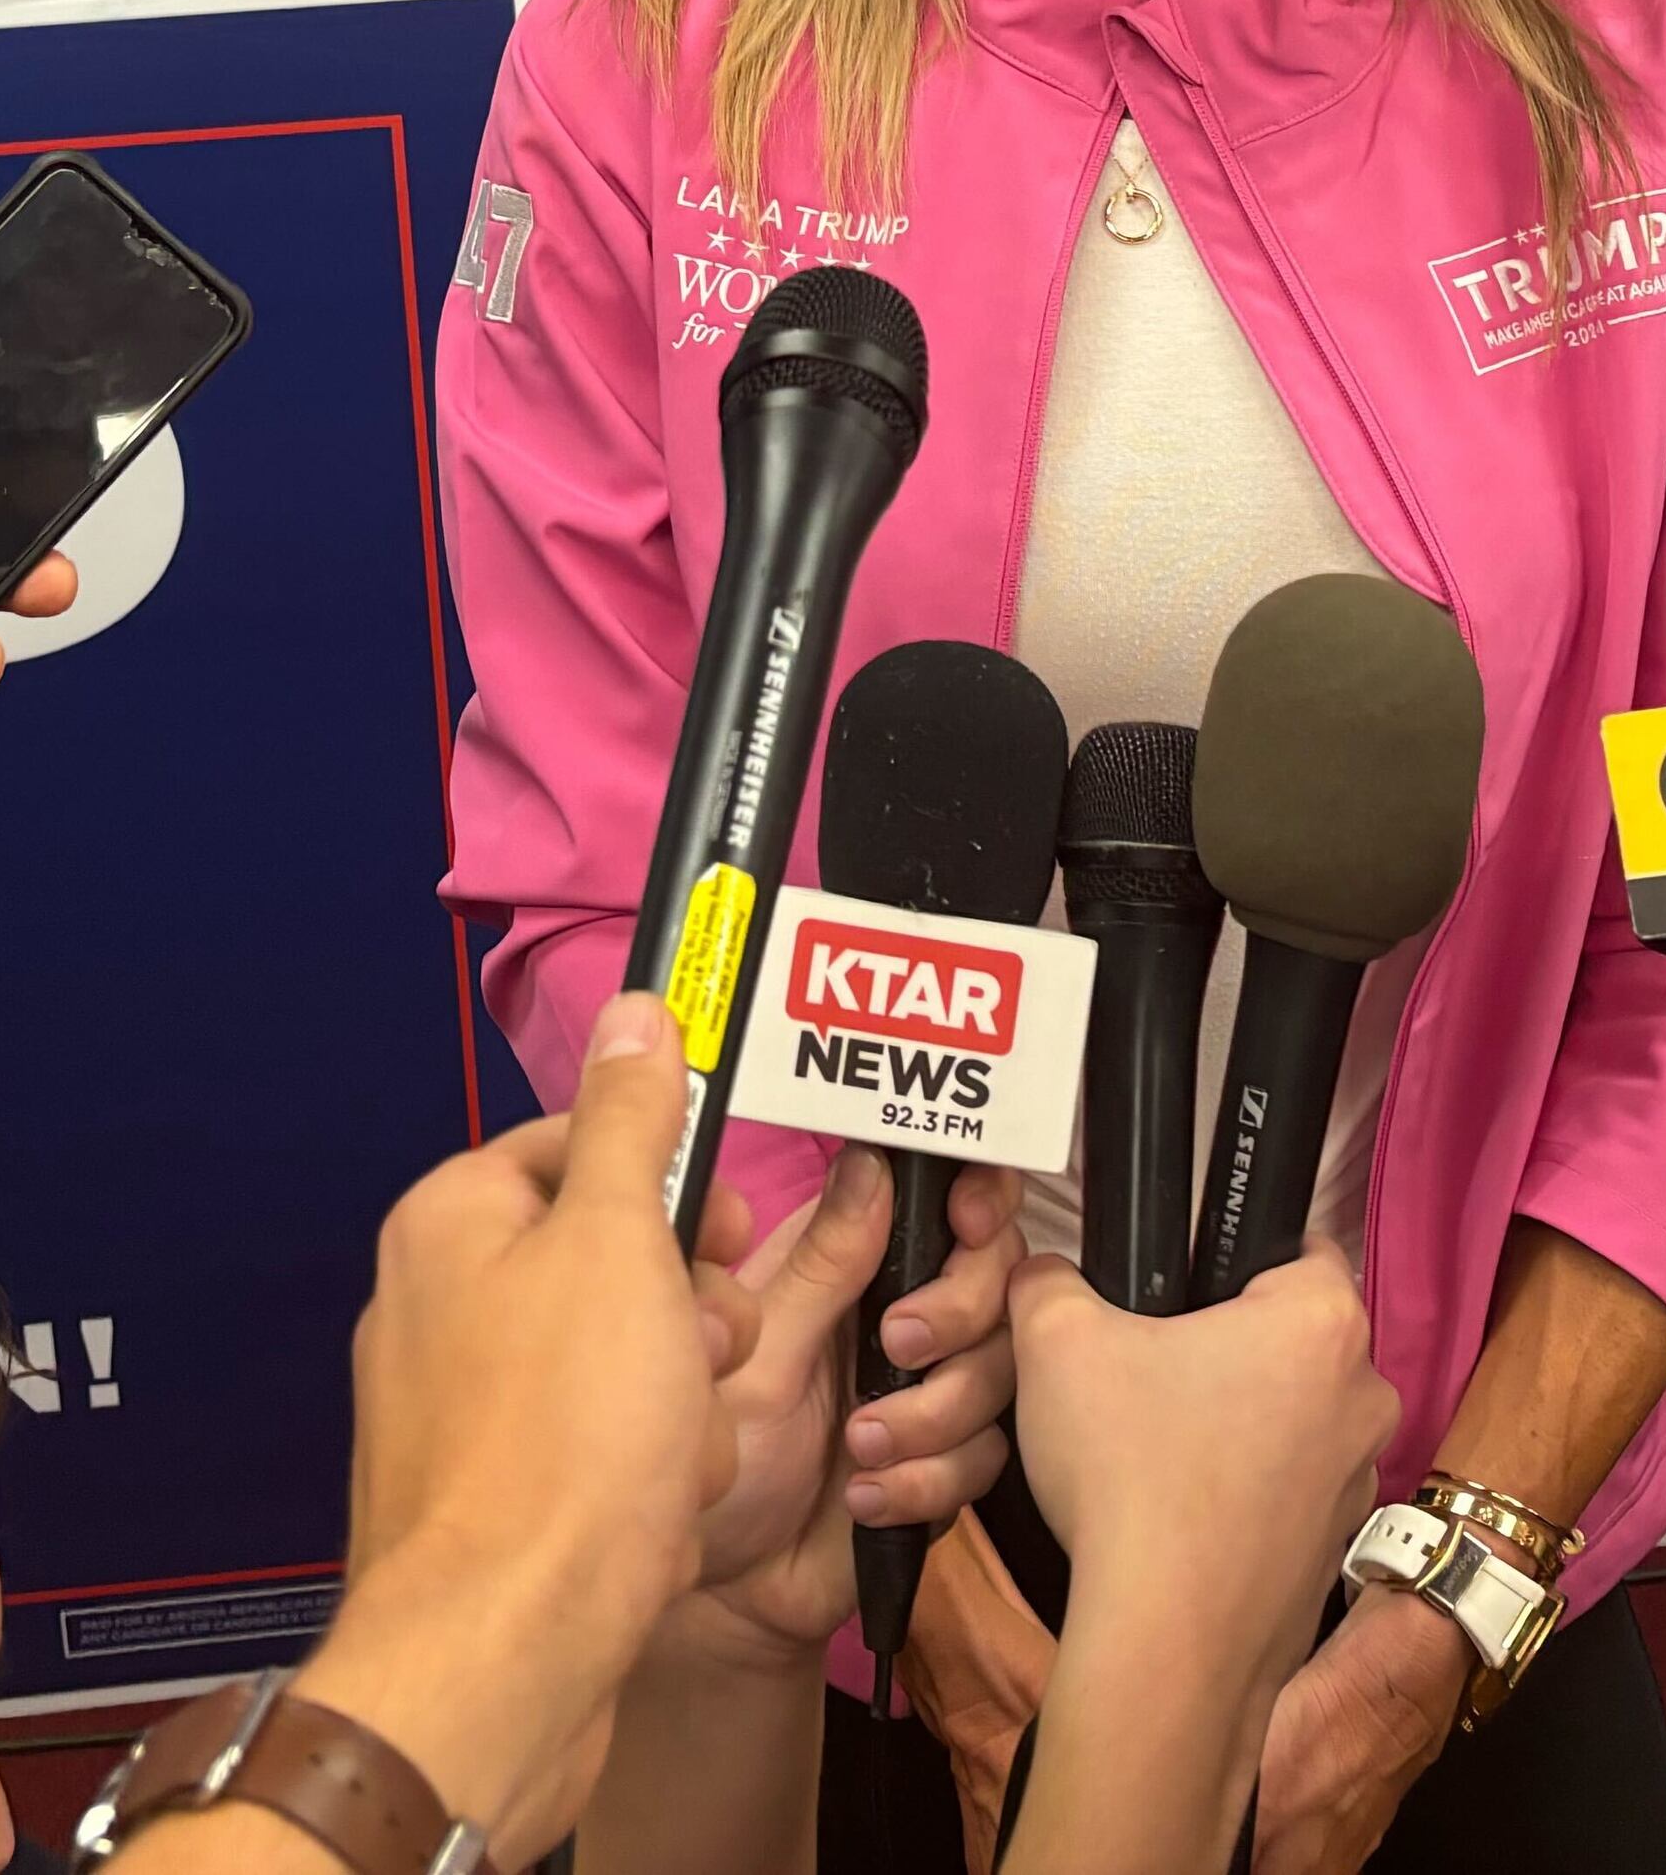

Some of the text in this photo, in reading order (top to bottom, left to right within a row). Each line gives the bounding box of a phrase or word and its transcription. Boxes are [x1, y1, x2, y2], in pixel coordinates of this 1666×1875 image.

[454, 178, 534, 323] 47
[794, 204, 910, 245] TRUMP
[671, 312, 726, 350] for
[1483, 322, 1525, 349] MAKE
[725, 651, 791, 851] SENNHEISER
[804, 941, 1003, 1037] KTAR
[793, 1029, 991, 1110] NEWS
[880, 1101, 984, 1143] 92.3 FM
